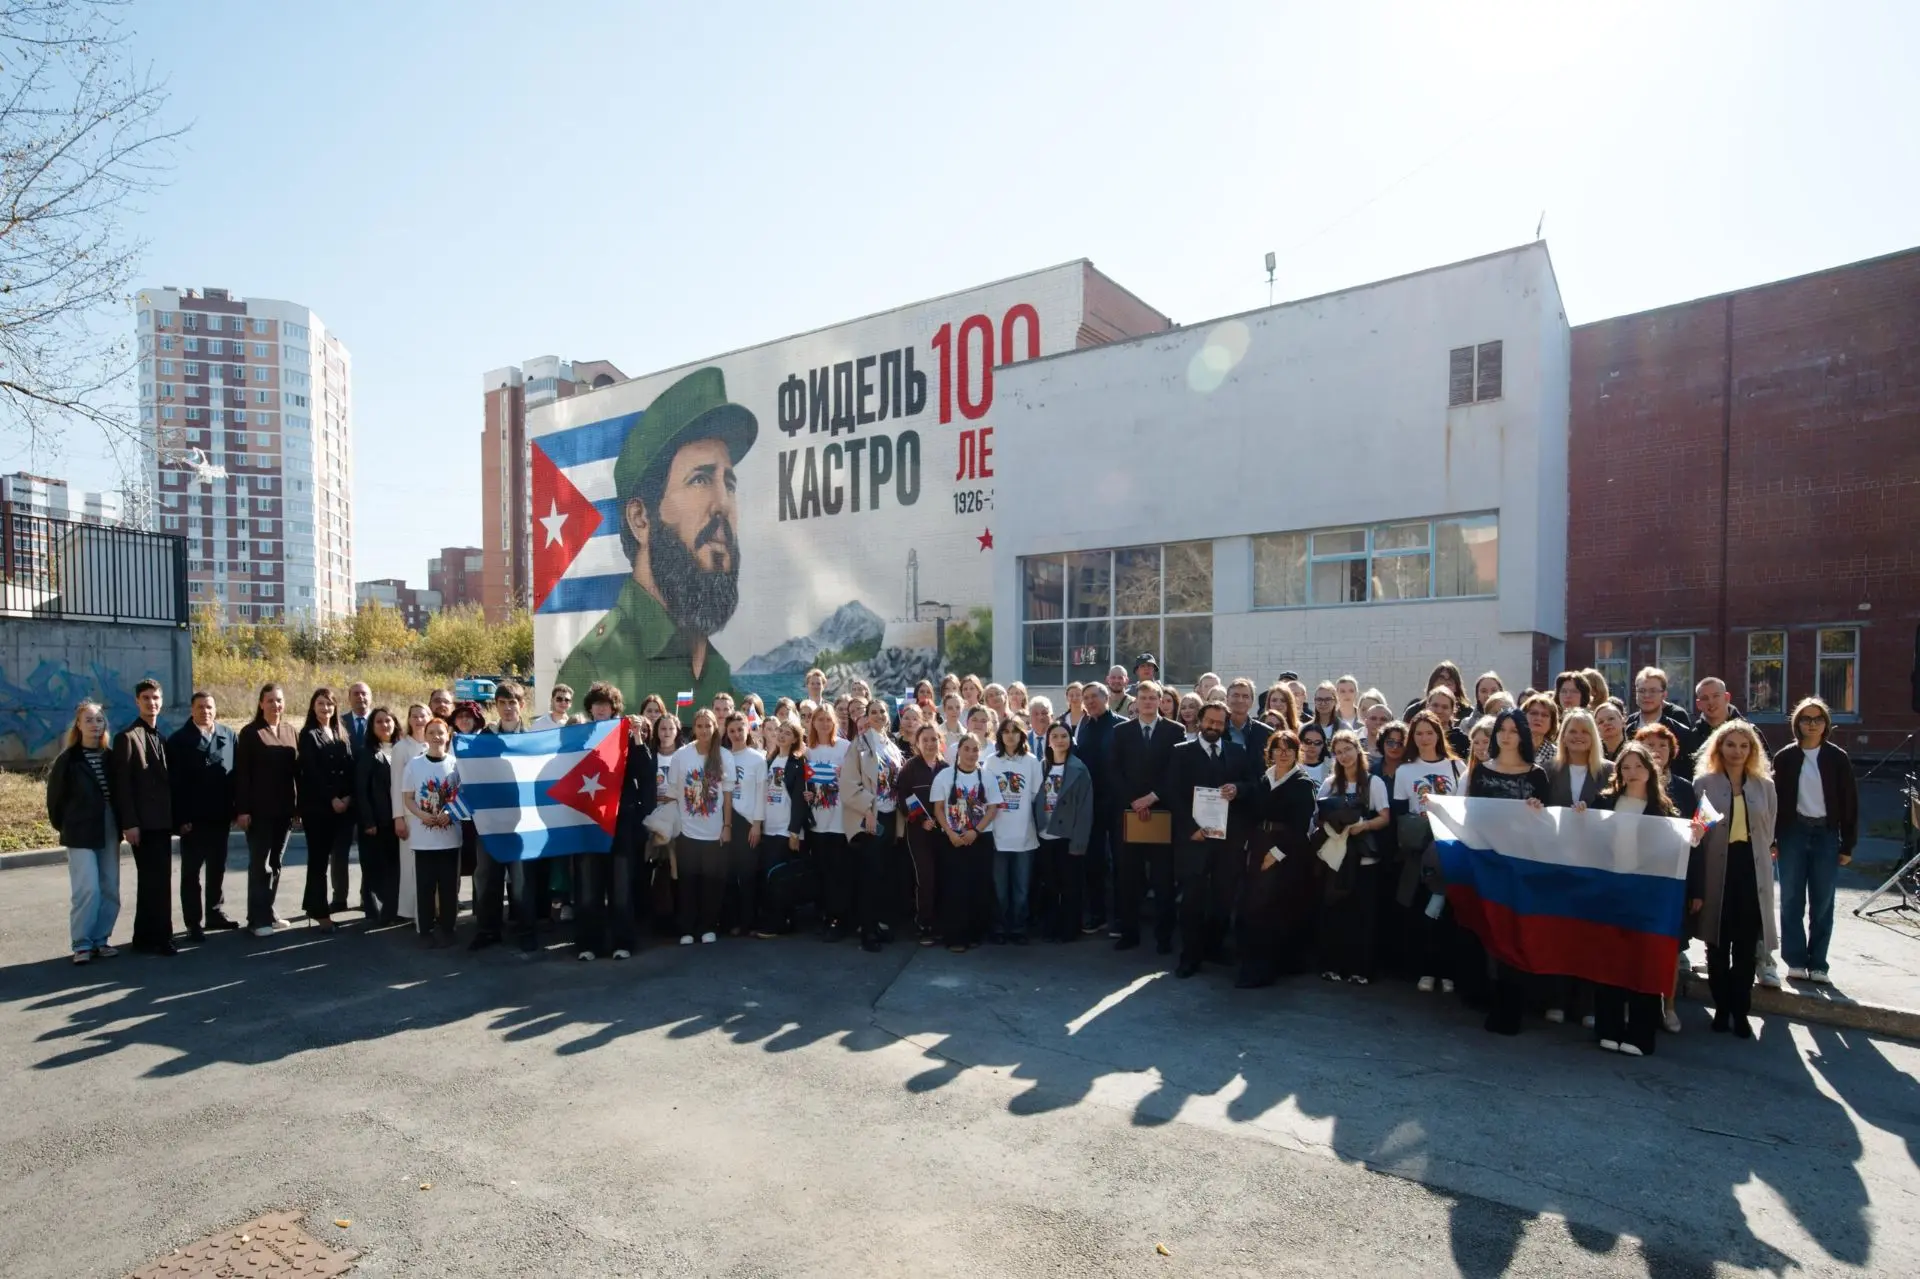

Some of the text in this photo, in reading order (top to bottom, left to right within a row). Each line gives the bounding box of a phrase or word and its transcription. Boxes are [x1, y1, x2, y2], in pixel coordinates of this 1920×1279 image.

[778, 346, 927, 437] ФИДЕЛЬ
[779, 429, 920, 521] КАСТРО
[953, 489, 994, 515] 1926-
